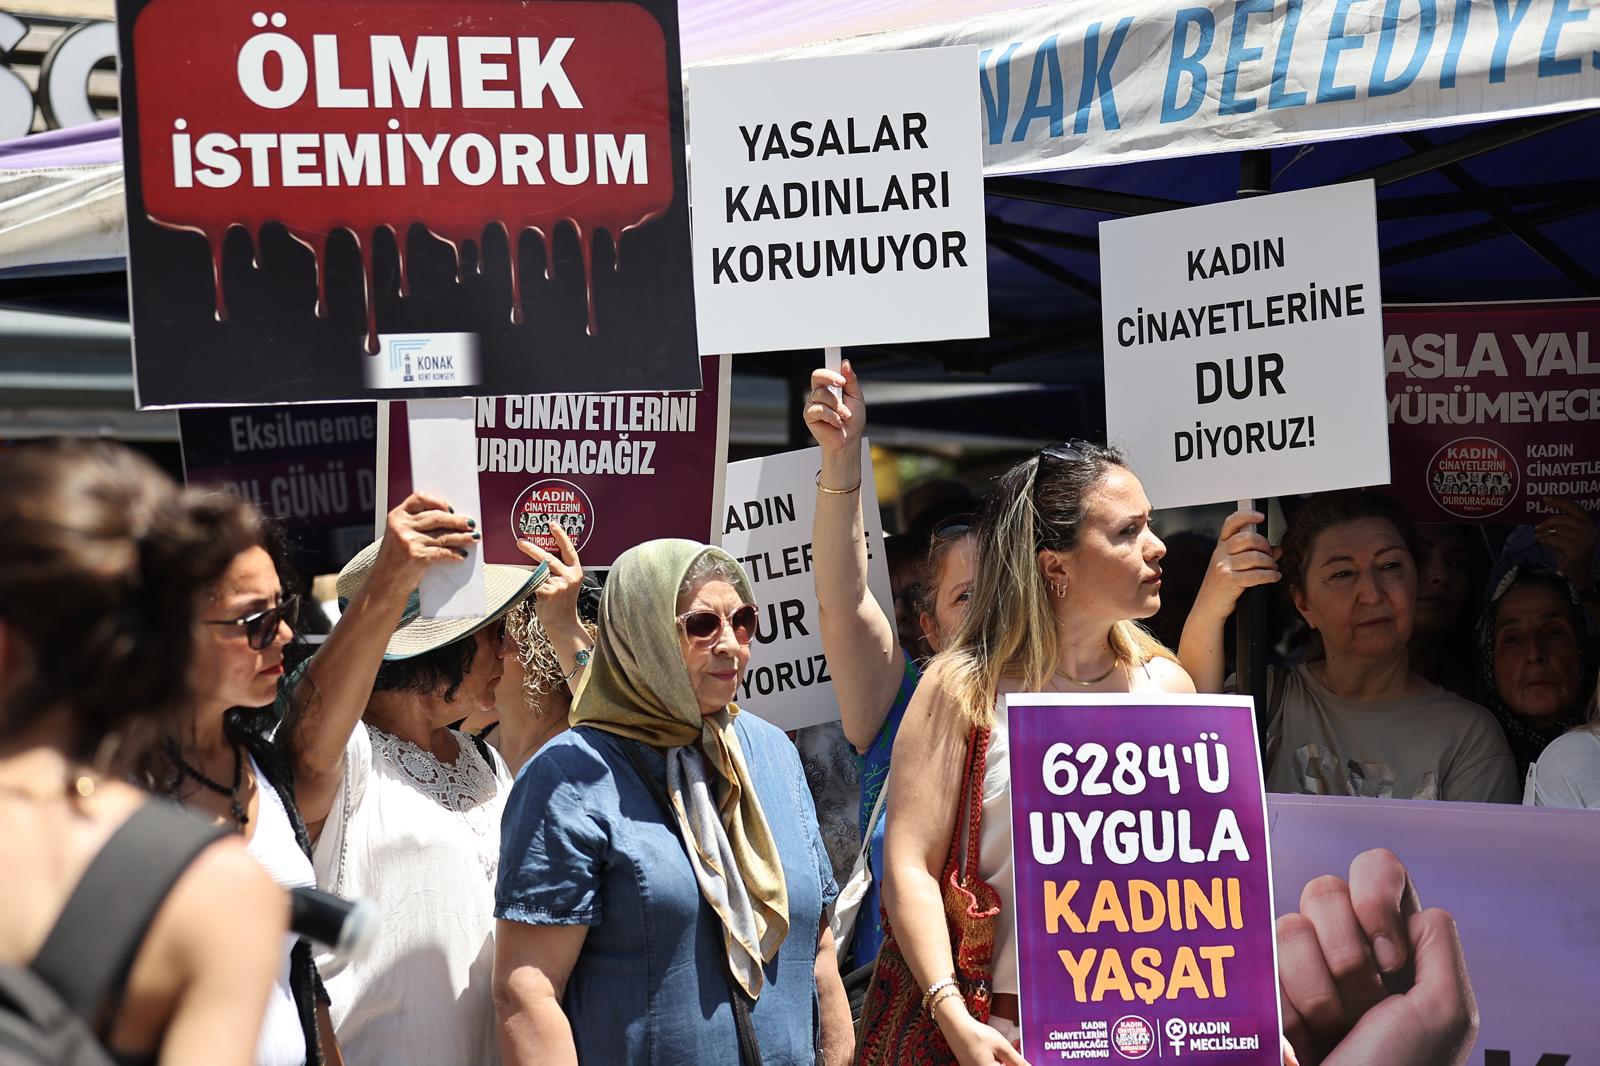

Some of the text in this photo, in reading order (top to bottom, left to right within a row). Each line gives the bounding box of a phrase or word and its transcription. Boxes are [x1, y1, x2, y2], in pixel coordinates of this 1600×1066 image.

[237, 11, 584, 109] ÖLMEK
[979, 16, 1135, 145] NAK
[172, 118, 649, 188] İSTEMİYORUM
[738, 112, 929, 162] YASALAR
[725, 170, 950, 224] KADINLARI
[712, 230, 969, 285] KORUMUYOR
[1187, 236, 1285, 282] KADIN
[1117, 282, 1365, 348] CİNAYETLERİNE
[417, 356, 454, 370] KONAK
[1195, 352, 1287, 405] DUR
[1385, 332, 1509, 379] ASLA
[476, 433, 657, 475] URDURACAĞIZ
[1174, 415, 1315, 463] DİYORUZ!
[1447, 447, 1498, 459] KADIN
[1526, 443, 1574, 458] KADIN
[1438, 458, 1506, 471] CİNAYETLERİNİ
[271, 461, 349, 518] GÜNÜ
[524, 500, 581, 513] CİNAYETLERİNİ
[532, 490, 575, 502] KADIN
[722, 493, 796, 535] ADIN
[754, 598, 810, 645] UR
[735, 653, 833, 701] YORUZ
[1042, 732, 1230, 796] 6284'Ü
[1029, 808, 1250, 865] UYGULA
[1043, 877, 1244, 934] KADINI
[1057, 945, 1235, 1005] YAŞAT
[1081, 1021, 1107, 1030] KADIN
[1189, 1021, 1231, 1035] KADIN
[1189, 1034, 1259, 1051] MECLİSLERİ
[1061, 1049, 1110, 1059] PLATFORMU
